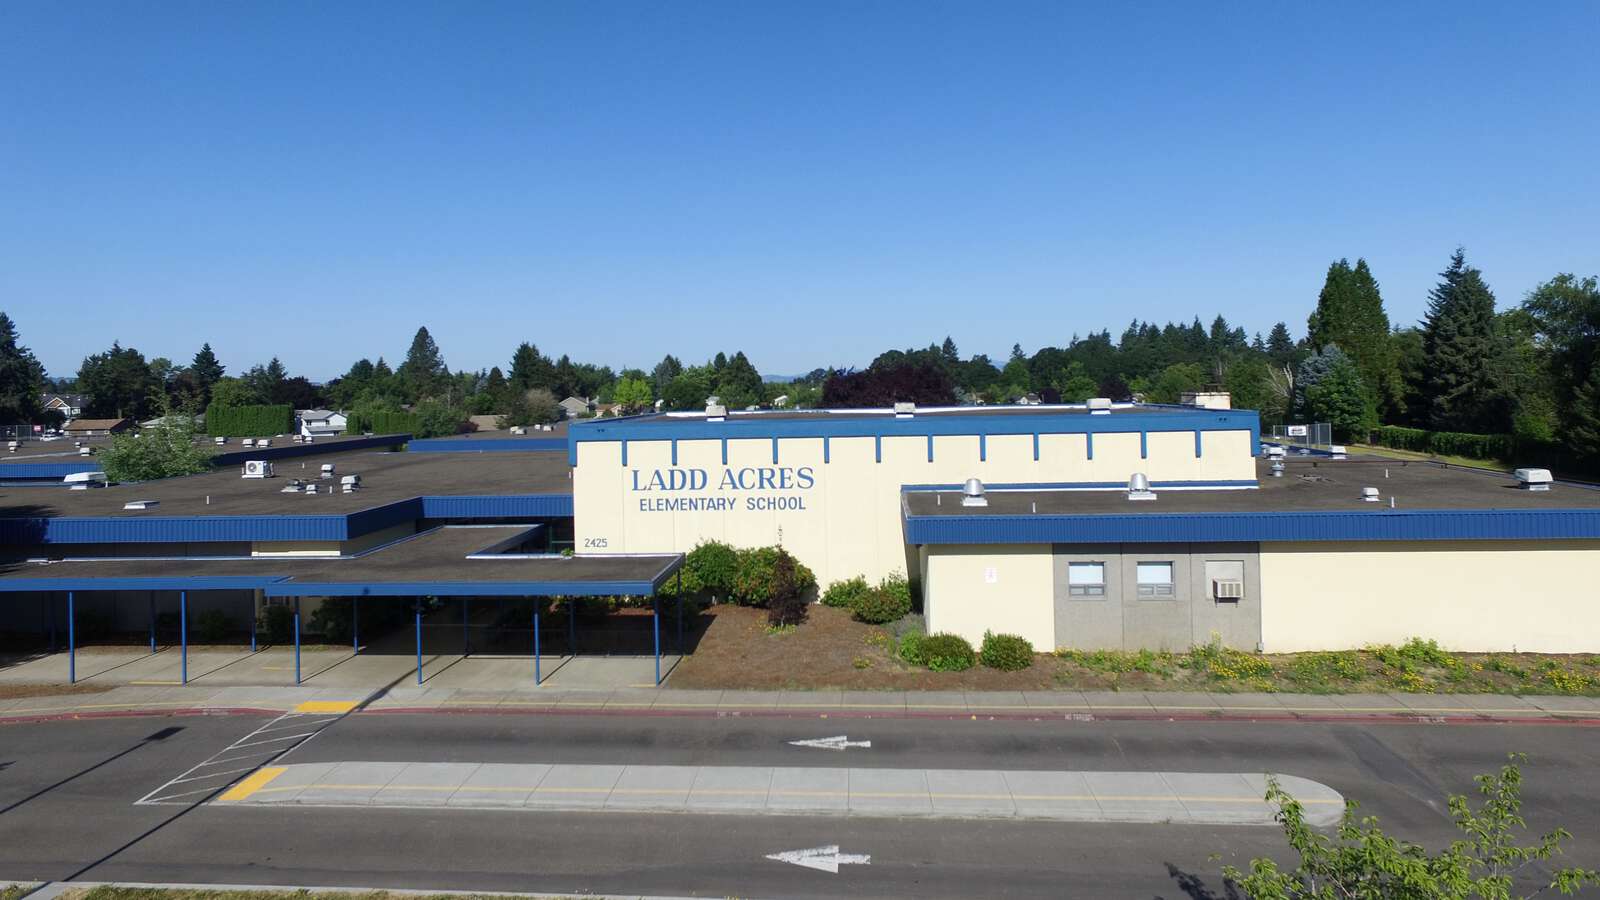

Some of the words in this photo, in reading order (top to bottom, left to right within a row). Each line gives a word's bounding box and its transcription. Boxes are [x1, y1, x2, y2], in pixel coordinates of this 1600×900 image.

[631, 468, 708, 491] LADD
[719, 467, 815, 490] ACRES
[639, 497, 736, 512] ELEMENTARY
[746, 496, 806, 511] SCHOOL
[584, 538, 608, 548] 2425
